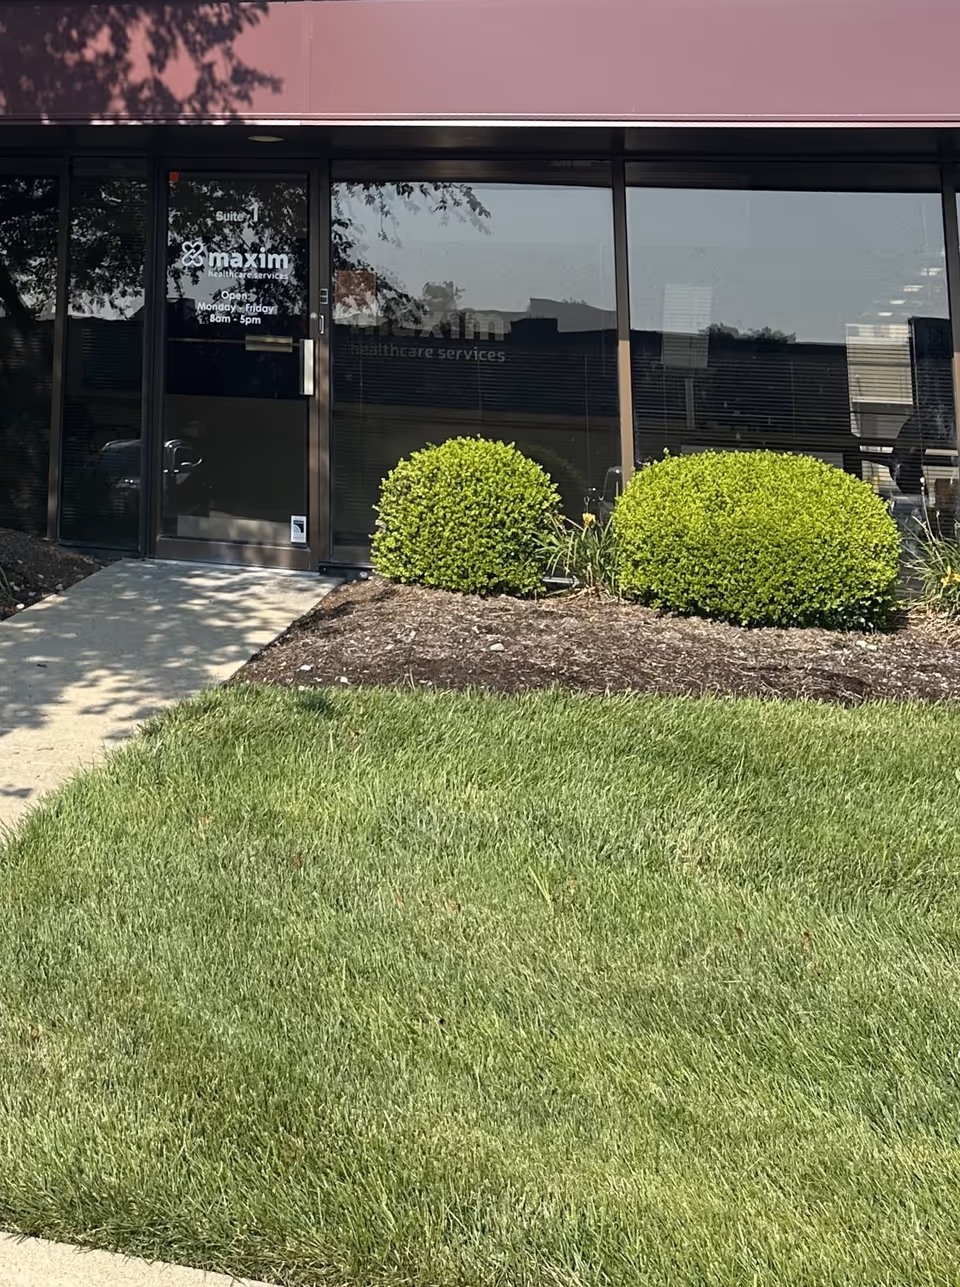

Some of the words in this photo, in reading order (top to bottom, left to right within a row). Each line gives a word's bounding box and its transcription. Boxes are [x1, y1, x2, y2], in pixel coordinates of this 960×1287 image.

[215, 211, 244, 222] Suite
[208, 247, 289, 269] maxim
[208, 270, 251, 280] healthcare
[253, 272, 289, 280] services
[197, 302, 236, 314] Monday
[245, 304, 275, 315] Friday
[209, 314, 231, 323] 8am
[240, 315, 262, 326] 5pm
[438, 346, 506, 362] services
